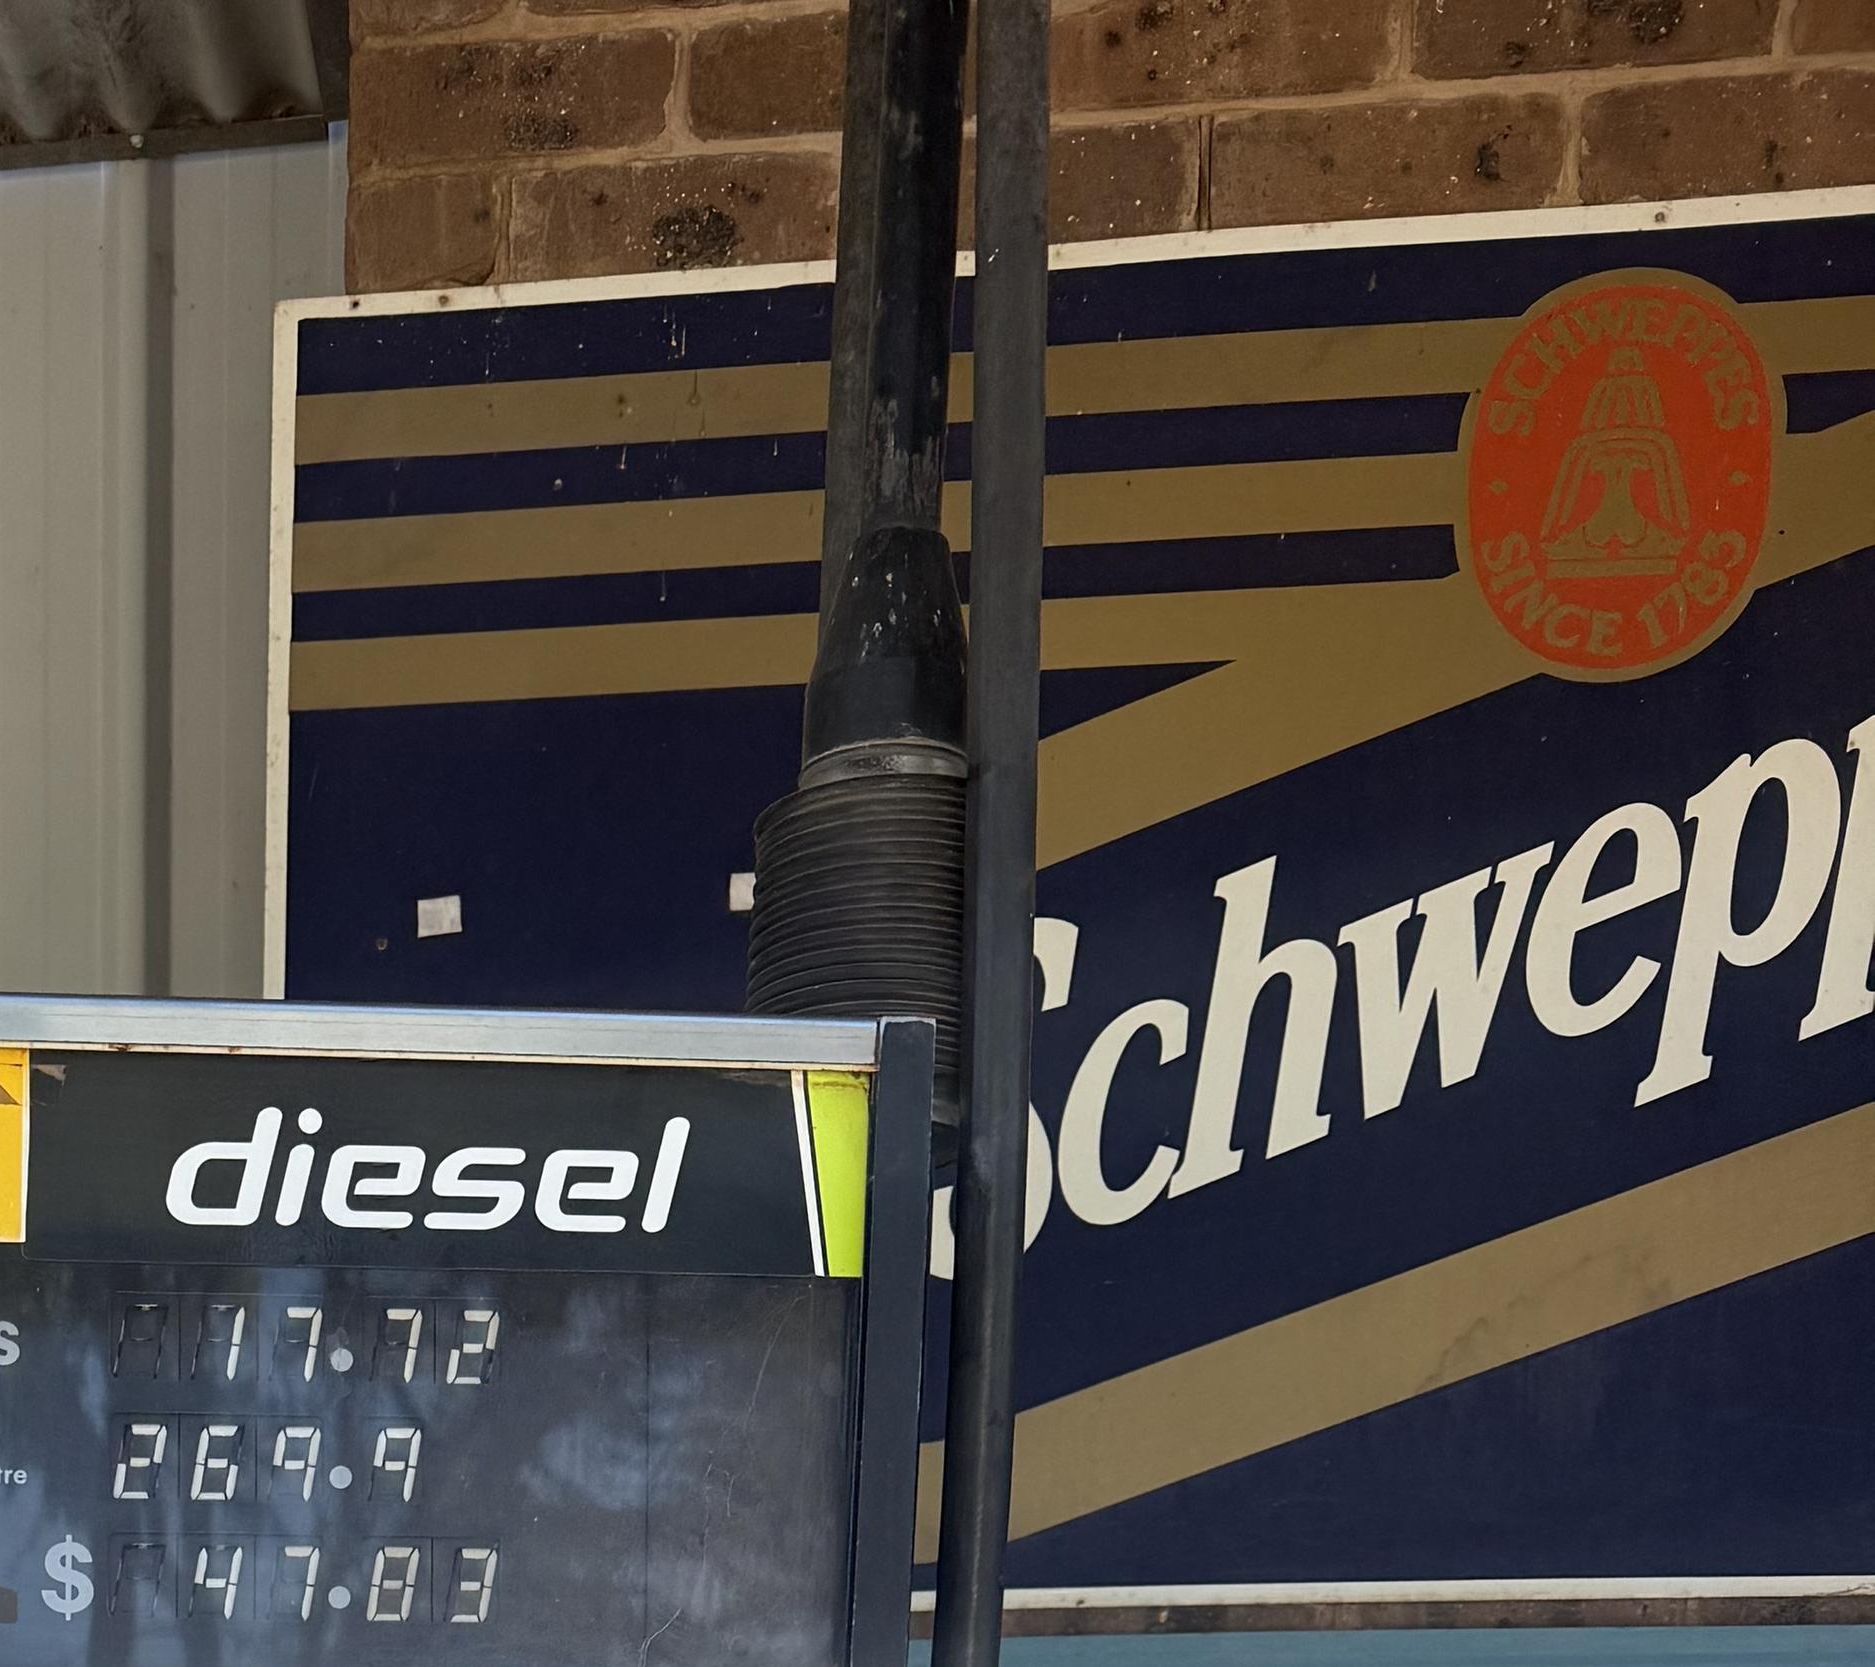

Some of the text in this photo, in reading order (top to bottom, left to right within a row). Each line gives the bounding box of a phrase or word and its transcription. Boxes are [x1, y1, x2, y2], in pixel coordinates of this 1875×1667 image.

[1488, 299, 1759, 437] SCHWEPPES
[1481, 528, 1747, 656] SINCE 1783
[165, 1105, 691, 1233] diesel
[226, 1306, 500, 1385] 17.72
[113, 1424, 422, 1502] 269.9
